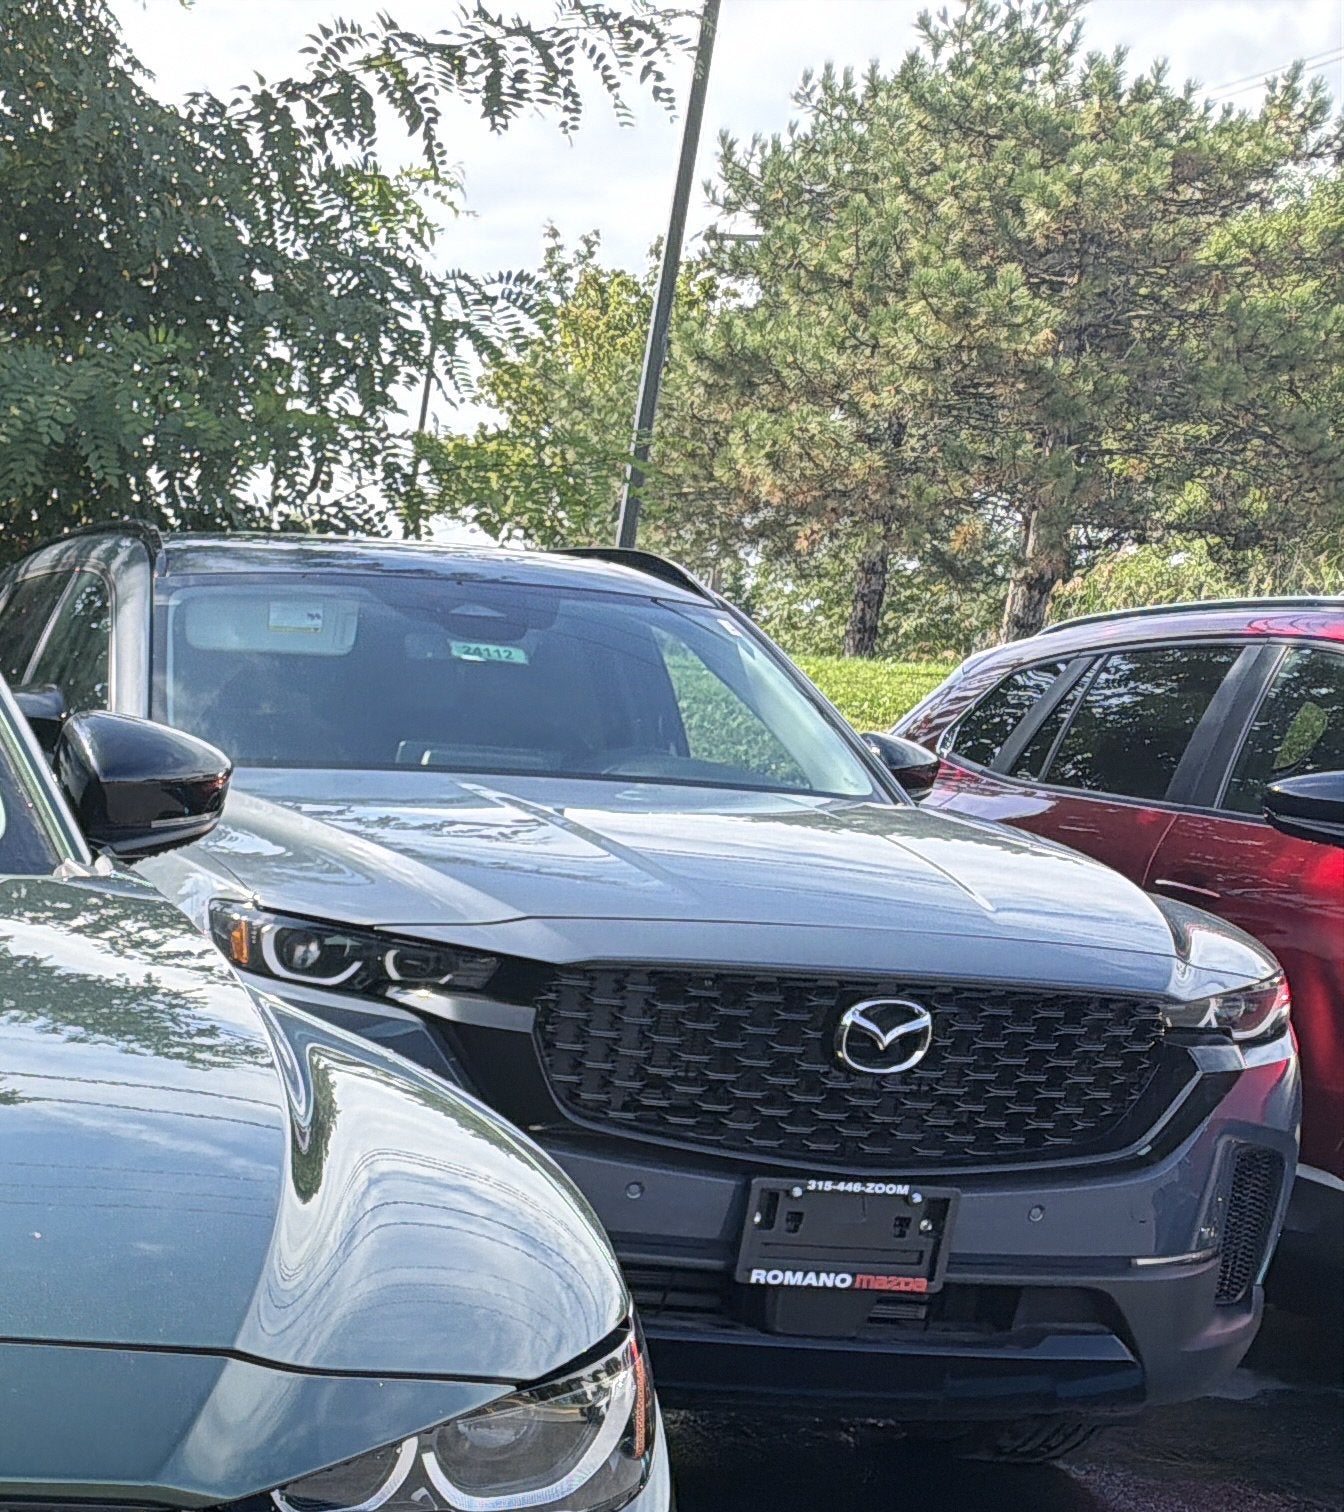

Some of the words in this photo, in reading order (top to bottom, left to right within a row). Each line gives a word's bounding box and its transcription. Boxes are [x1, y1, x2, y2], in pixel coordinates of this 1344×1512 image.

[462, 645, 515, 660] 24112
[806, 1180, 910, 1195] 315-446-ZOOM
[750, 1269, 853, 1288] ROMANO
